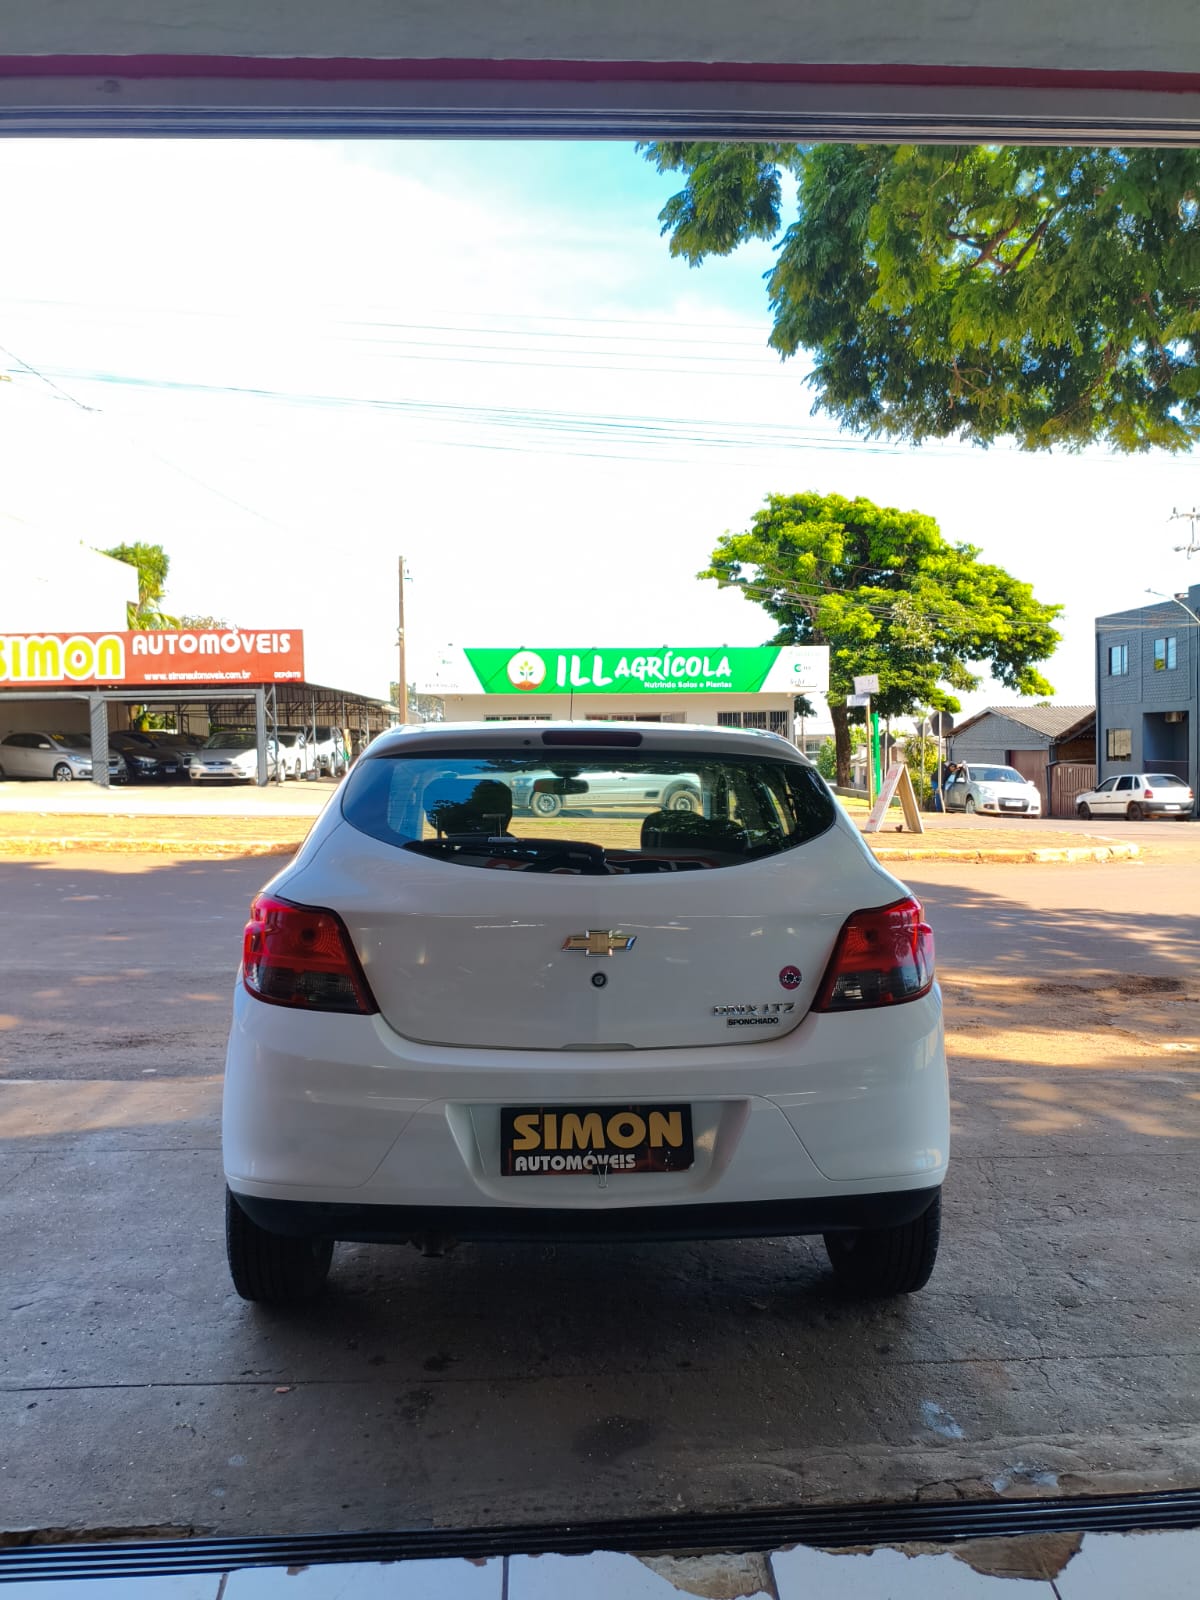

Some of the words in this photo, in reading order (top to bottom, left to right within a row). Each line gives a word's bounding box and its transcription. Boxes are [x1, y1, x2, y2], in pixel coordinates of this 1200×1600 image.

[132, 629, 291, 655] AUTOMÓVEIS
[556, 655, 613, 687] ILL
[614, 651, 732, 681] AGRÍCOLA
[728, 1017, 779, 1026] SPONCHIADO
[512, 1111, 683, 1150] SIMON
[515, 1150, 637, 1171] AUTOMÓVEIS
